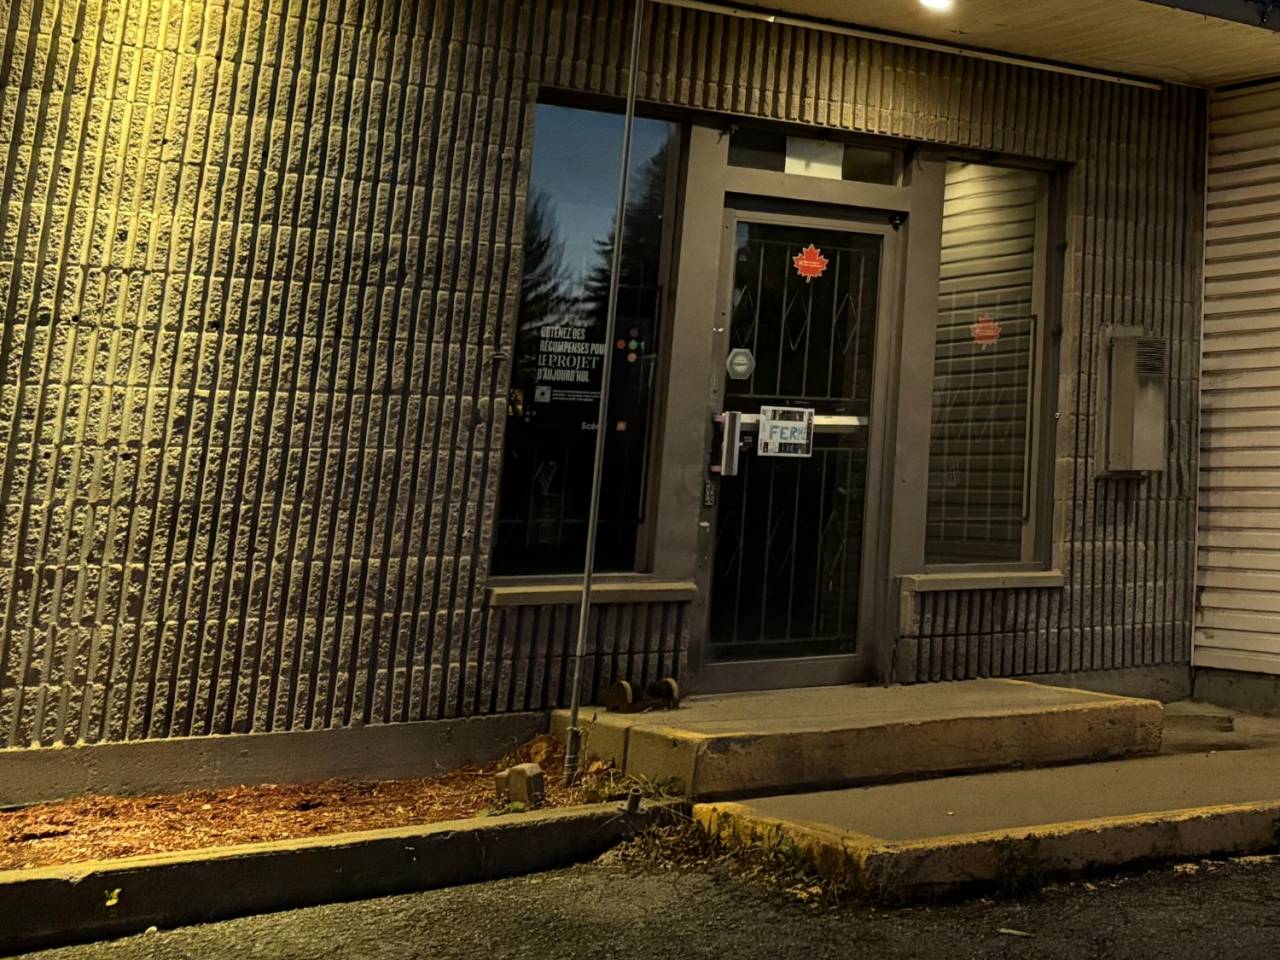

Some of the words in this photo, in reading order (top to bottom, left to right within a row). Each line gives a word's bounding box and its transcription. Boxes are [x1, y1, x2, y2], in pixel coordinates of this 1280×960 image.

[540, 326, 571, 340] OBTENEZ
[572, 327, 585, 340] DES
[590, 343, 606, 355] POU
[538, 354, 547, 366] LE
[548, 354, 599, 370] PROJET
